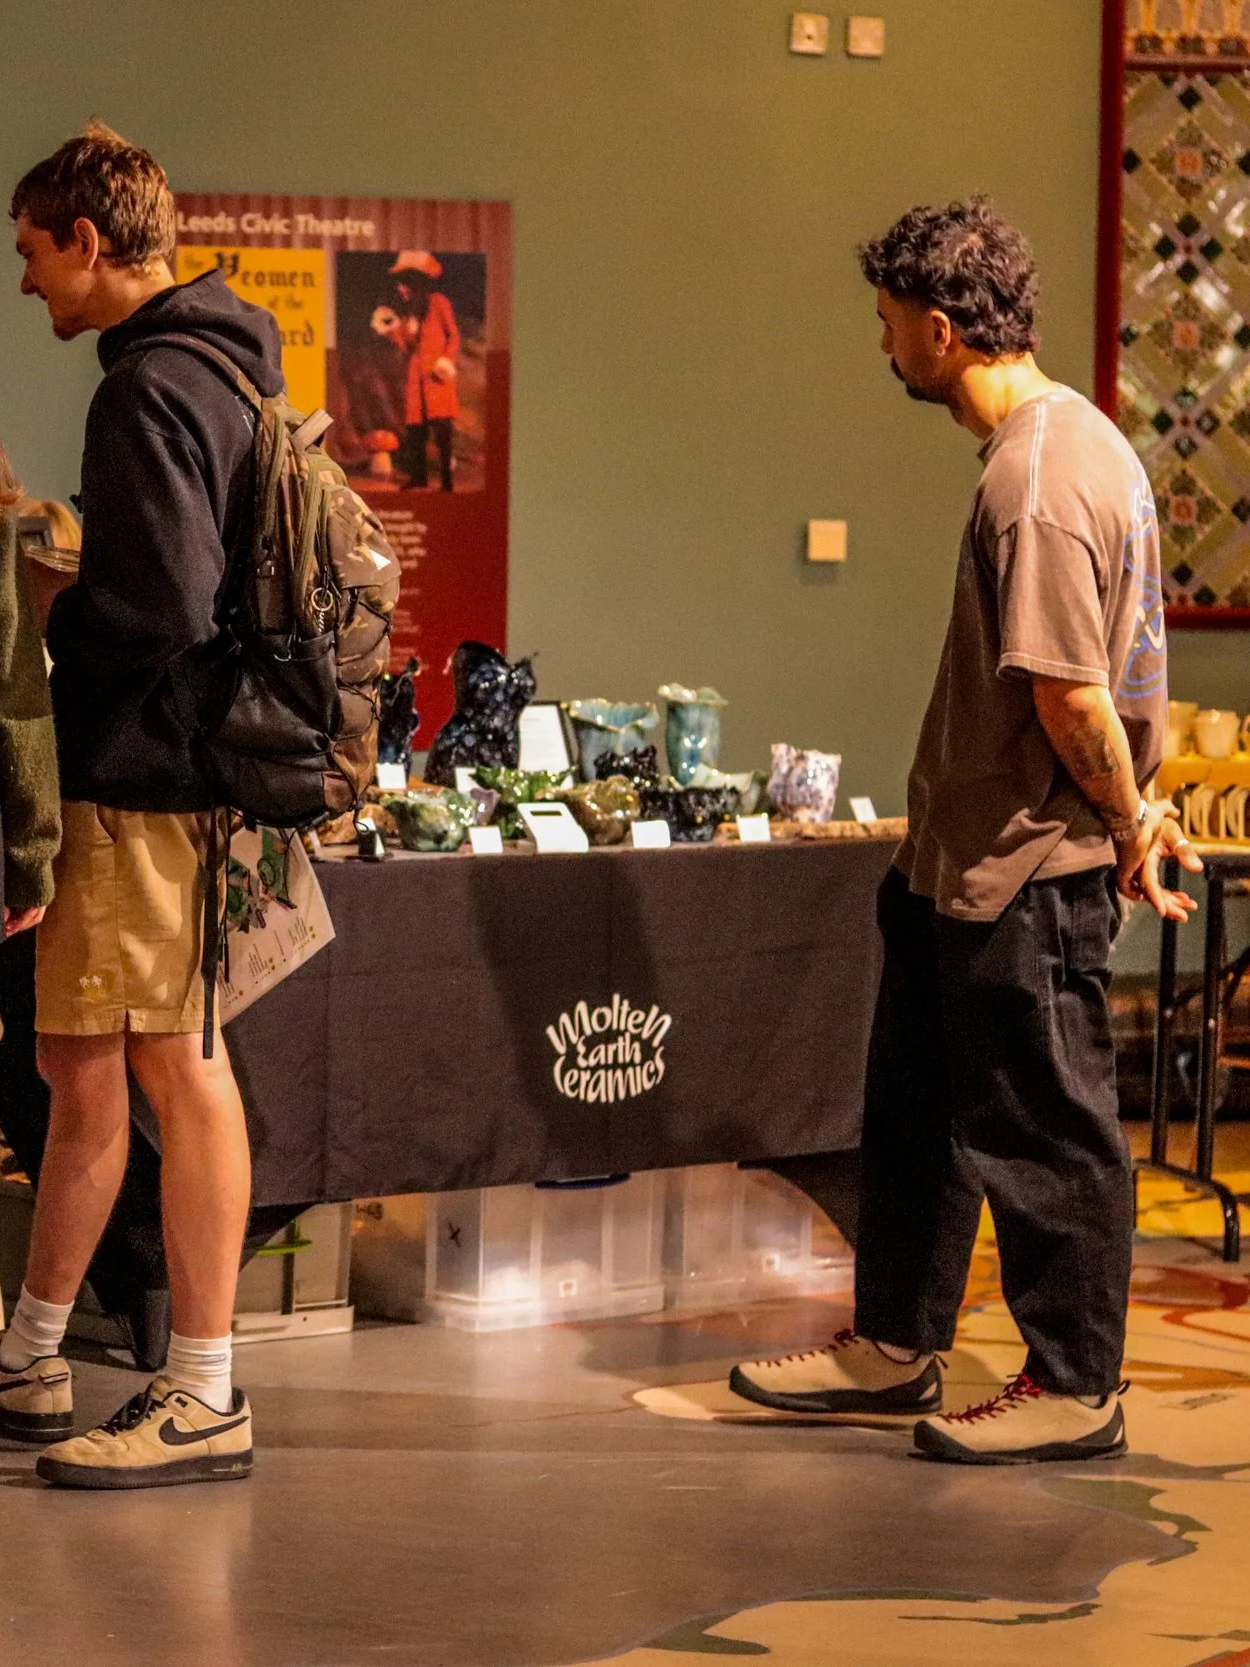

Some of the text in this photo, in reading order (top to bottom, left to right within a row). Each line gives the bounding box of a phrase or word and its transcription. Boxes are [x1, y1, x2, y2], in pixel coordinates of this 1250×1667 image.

[177, 212, 375, 237] Leeds Civic Theatre
[546, 992, 672, 1055] Molten
[577, 1032, 641, 1068] Earth
[553, 1046, 665, 1103] Ceramics
